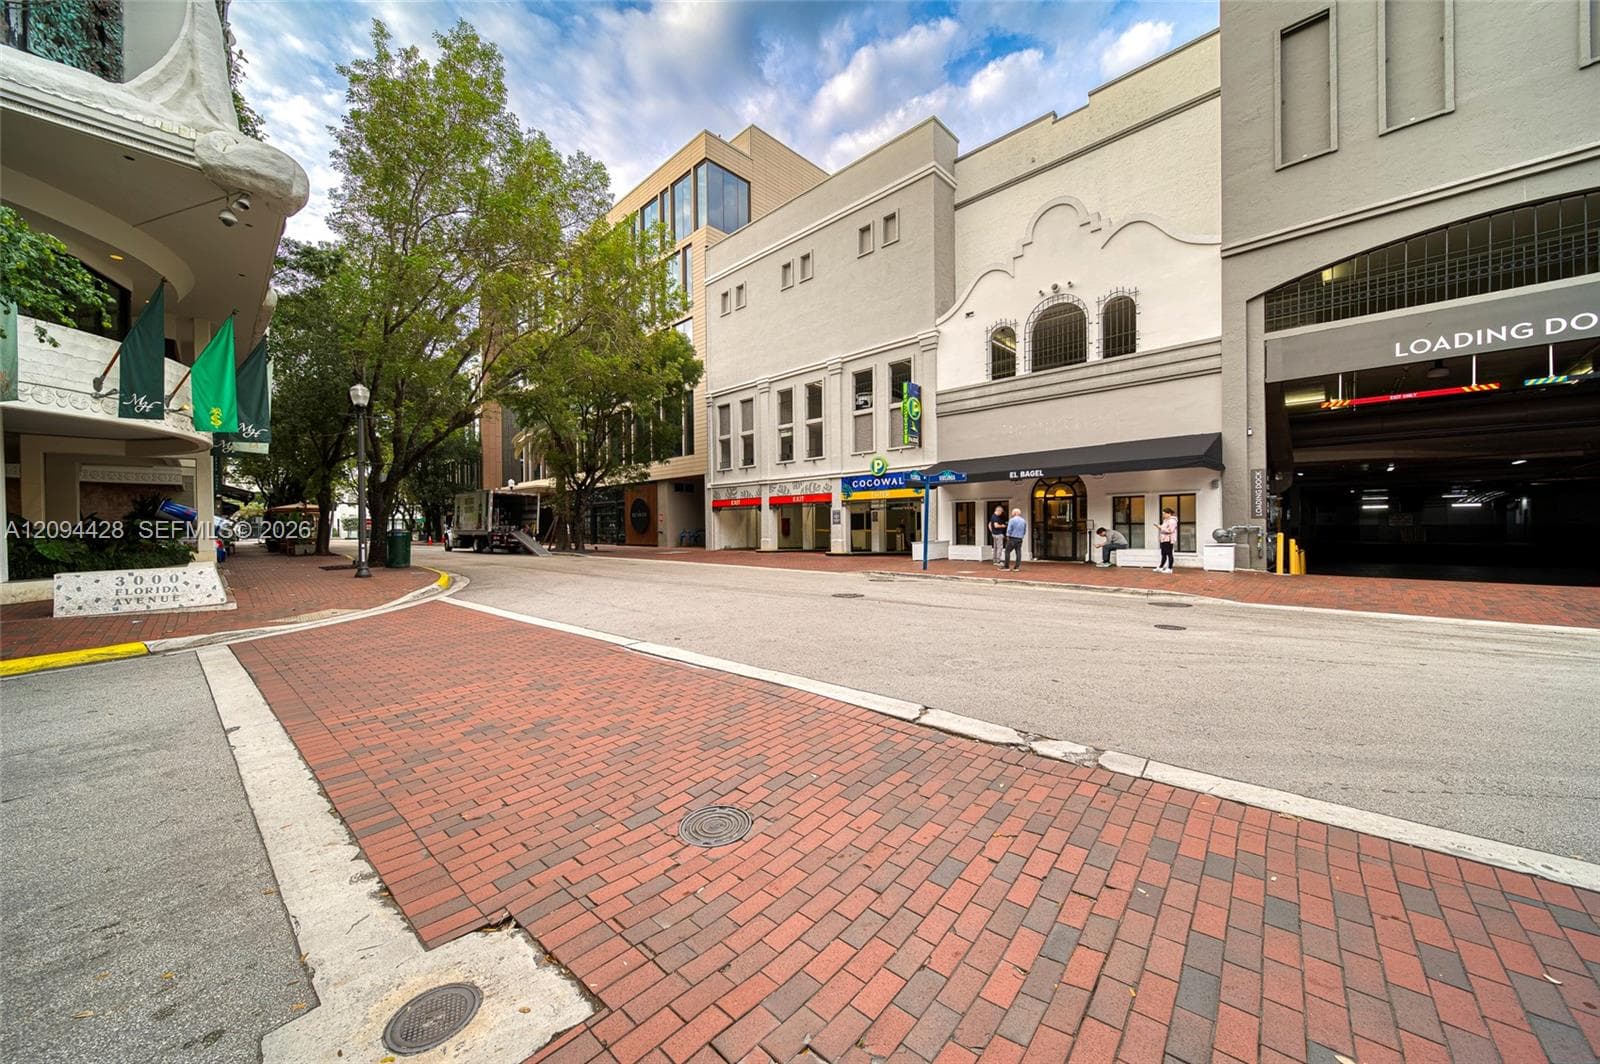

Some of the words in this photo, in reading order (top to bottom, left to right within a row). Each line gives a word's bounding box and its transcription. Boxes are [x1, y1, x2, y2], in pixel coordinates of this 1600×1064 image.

[1395, 322, 1534, 357] LOADING
[1009, 471, 1019, 479] EL
[1020, 469, 1044, 478] BAGEL
[852, 477, 905, 488] COCOWAL
[115, 574, 179, 586] 3000
[115, 586, 179, 596] FLORIDA
[113, 595, 180, 606] AVENUE
